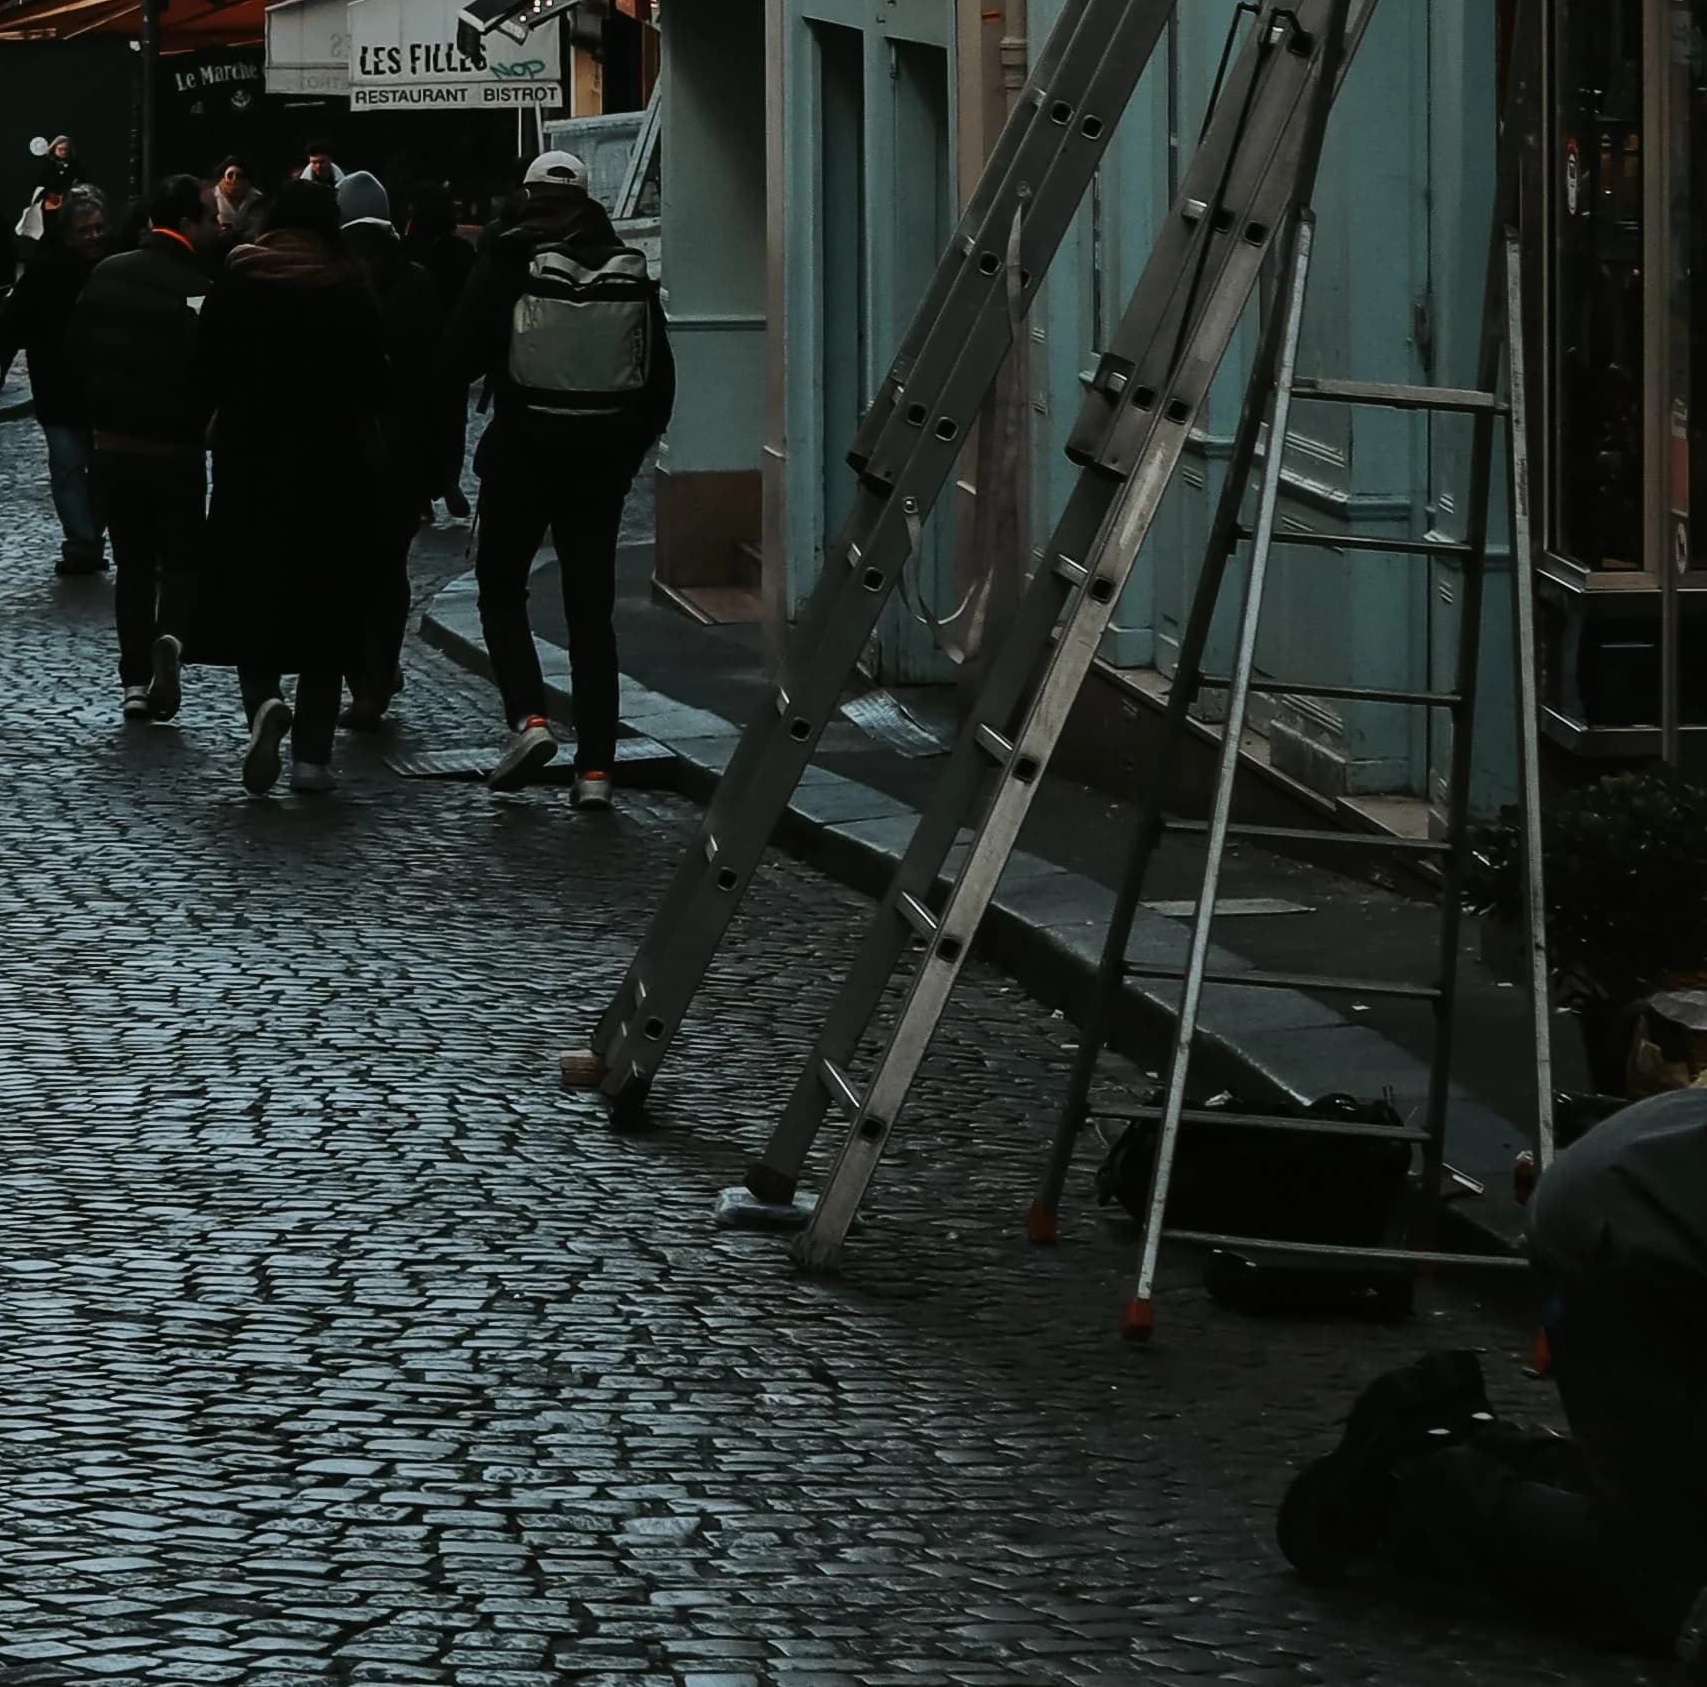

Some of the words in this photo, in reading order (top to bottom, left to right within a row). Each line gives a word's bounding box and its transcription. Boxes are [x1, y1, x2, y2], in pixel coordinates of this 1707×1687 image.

[359, 45, 401, 75] LES
[174, 72, 197, 92] Le
[355, 87, 468, 104] RESTAURANT
[484, 86, 559, 102] BISTROT
